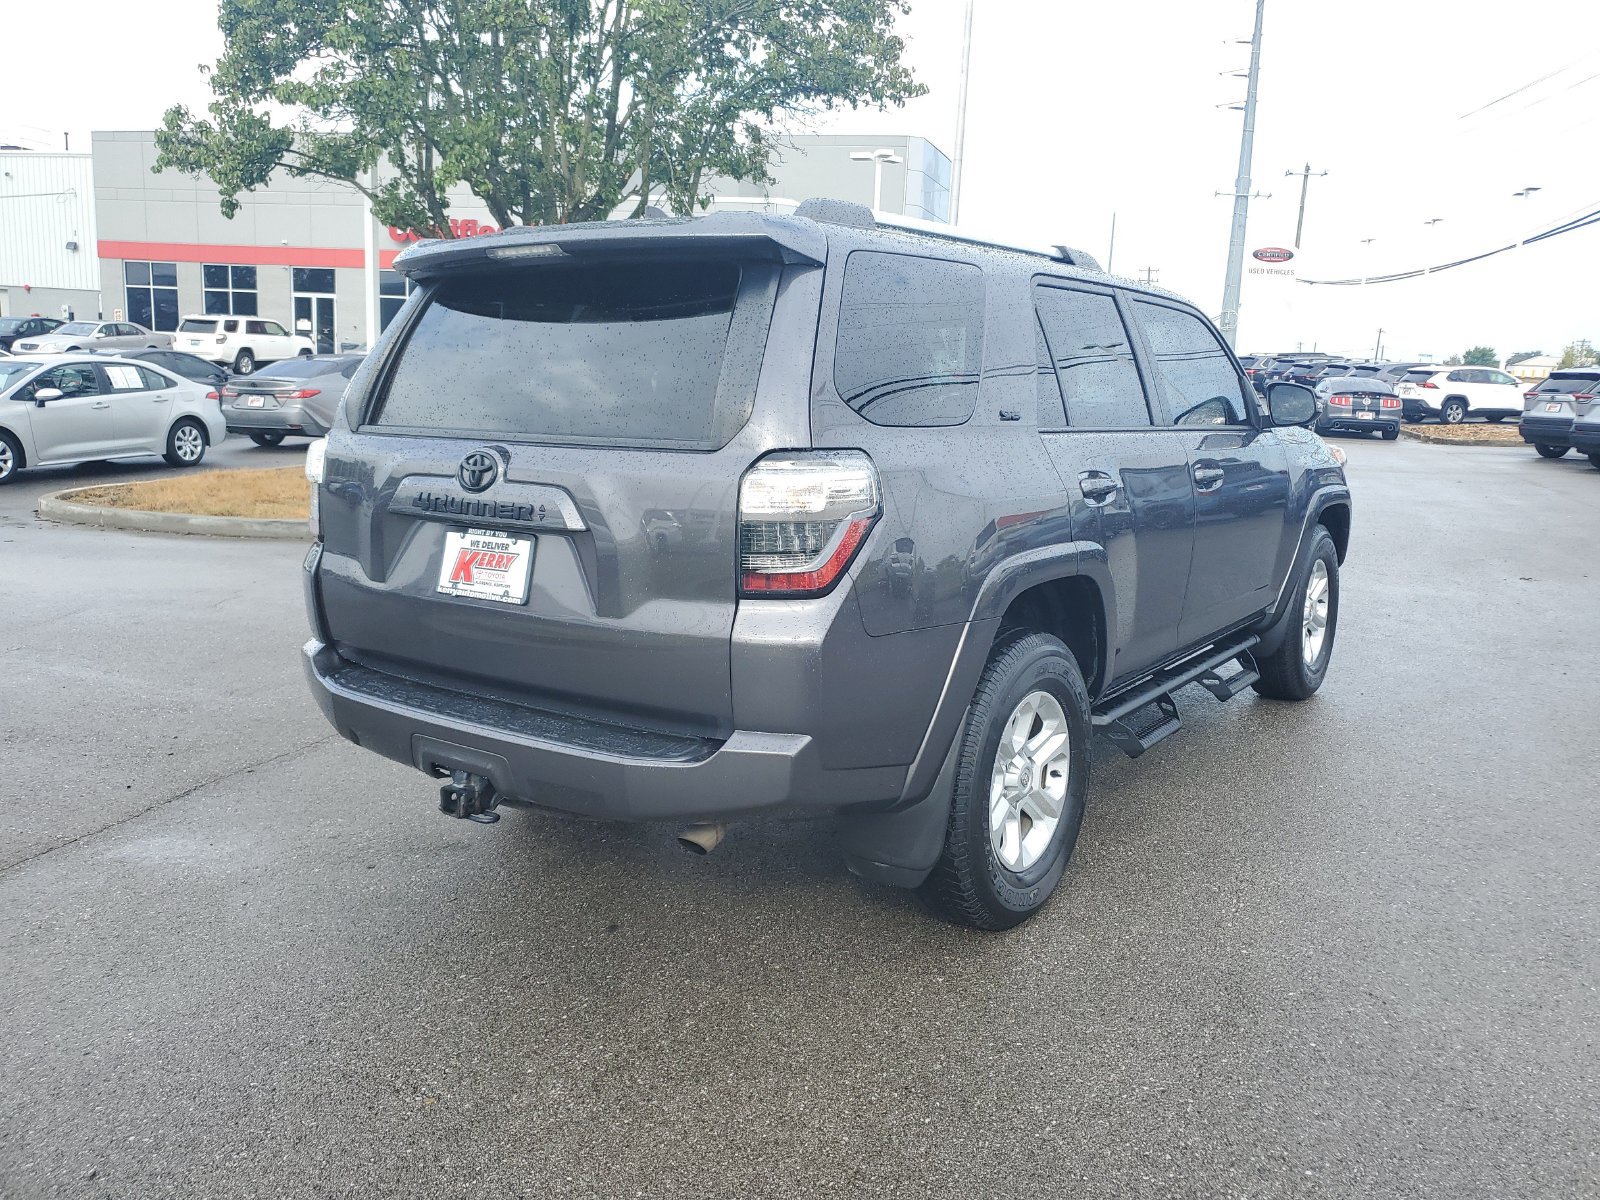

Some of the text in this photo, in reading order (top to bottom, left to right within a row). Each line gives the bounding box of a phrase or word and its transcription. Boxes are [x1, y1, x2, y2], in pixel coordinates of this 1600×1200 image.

[1266, 268, 1295, 276] VEHICLES
[412, 491, 535, 521] 4RUNNER
[467, 528, 508, 538] RIGHT BY YOU
[470, 540, 510, 551] WE DELIVER
[449, 548, 519, 585] KERRY
[484, 571, 506, 580] TOYOTA
